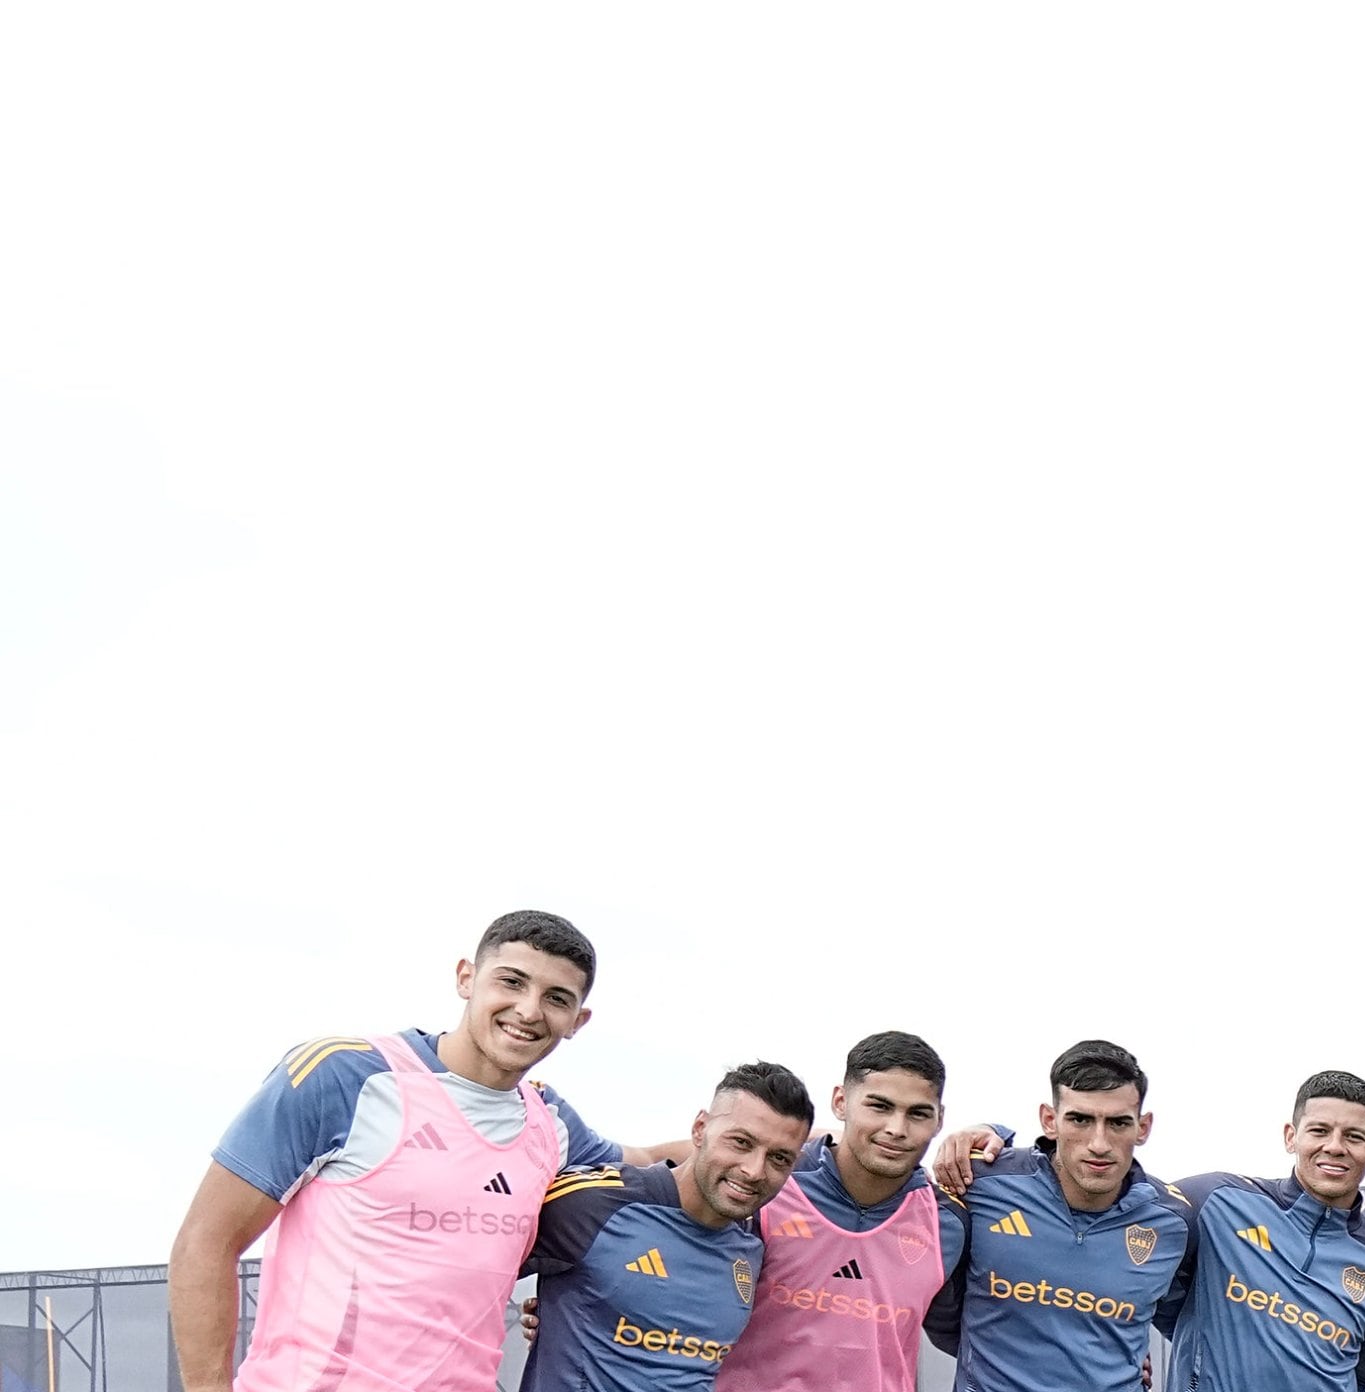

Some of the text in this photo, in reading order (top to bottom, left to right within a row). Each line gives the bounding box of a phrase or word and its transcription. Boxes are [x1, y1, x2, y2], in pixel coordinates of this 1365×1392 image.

[1129, 1236, 1151, 1250] CABJ
[990, 1270, 1136, 1322] betsson
[1226, 1274, 1350, 1349] betsson
